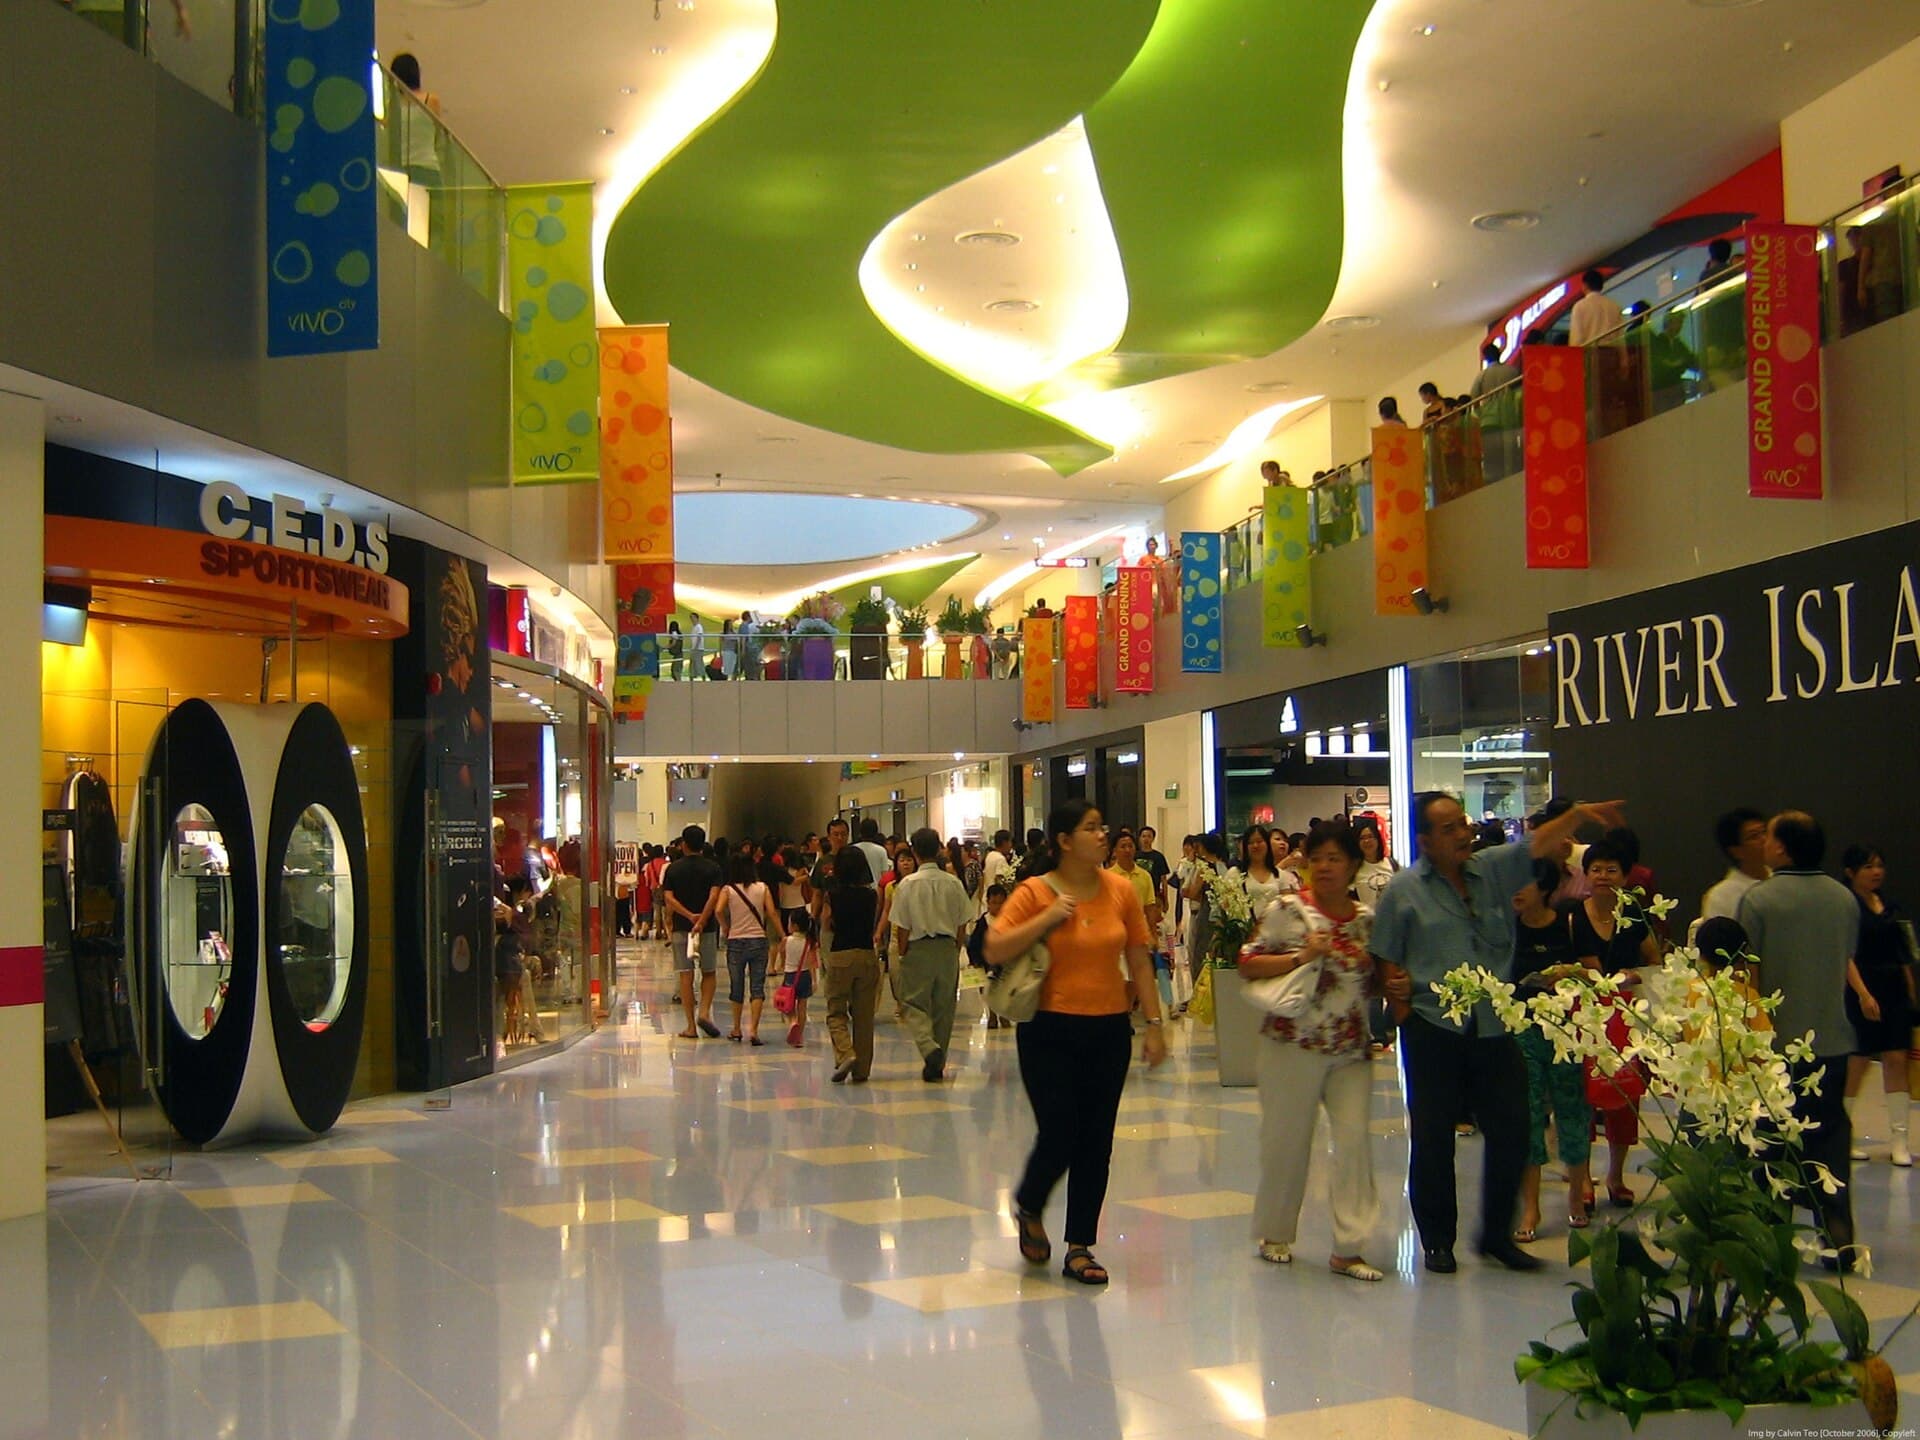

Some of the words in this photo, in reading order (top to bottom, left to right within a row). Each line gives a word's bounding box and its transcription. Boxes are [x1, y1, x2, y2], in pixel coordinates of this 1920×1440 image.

[1774, 235, 1787, 272] 2006
[1751, 233, 1772, 350] OPENING
[1775, 274, 1788, 297] Dec
[287, 309, 345, 336] VIVO
[1754, 357, 1773, 452] GRAND
[529, 452, 573, 472] VIVO
[200, 480, 389, 575] C.E.D.S
[617, 538, 653, 554] VIVO
[200, 541, 390, 611] SPORTSWEAR
[1119, 571, 1129, 626] OPENING
[1119, 628, 1129, 672] GRAND
[1551, 612, 1738, 730] RIVER
[1763, 565, 1920, 702] ISLA
[649, 812, 655, 825] 1
[613, 861, 636, 874] OPEN
[615, 846, 635, 860] NOW
